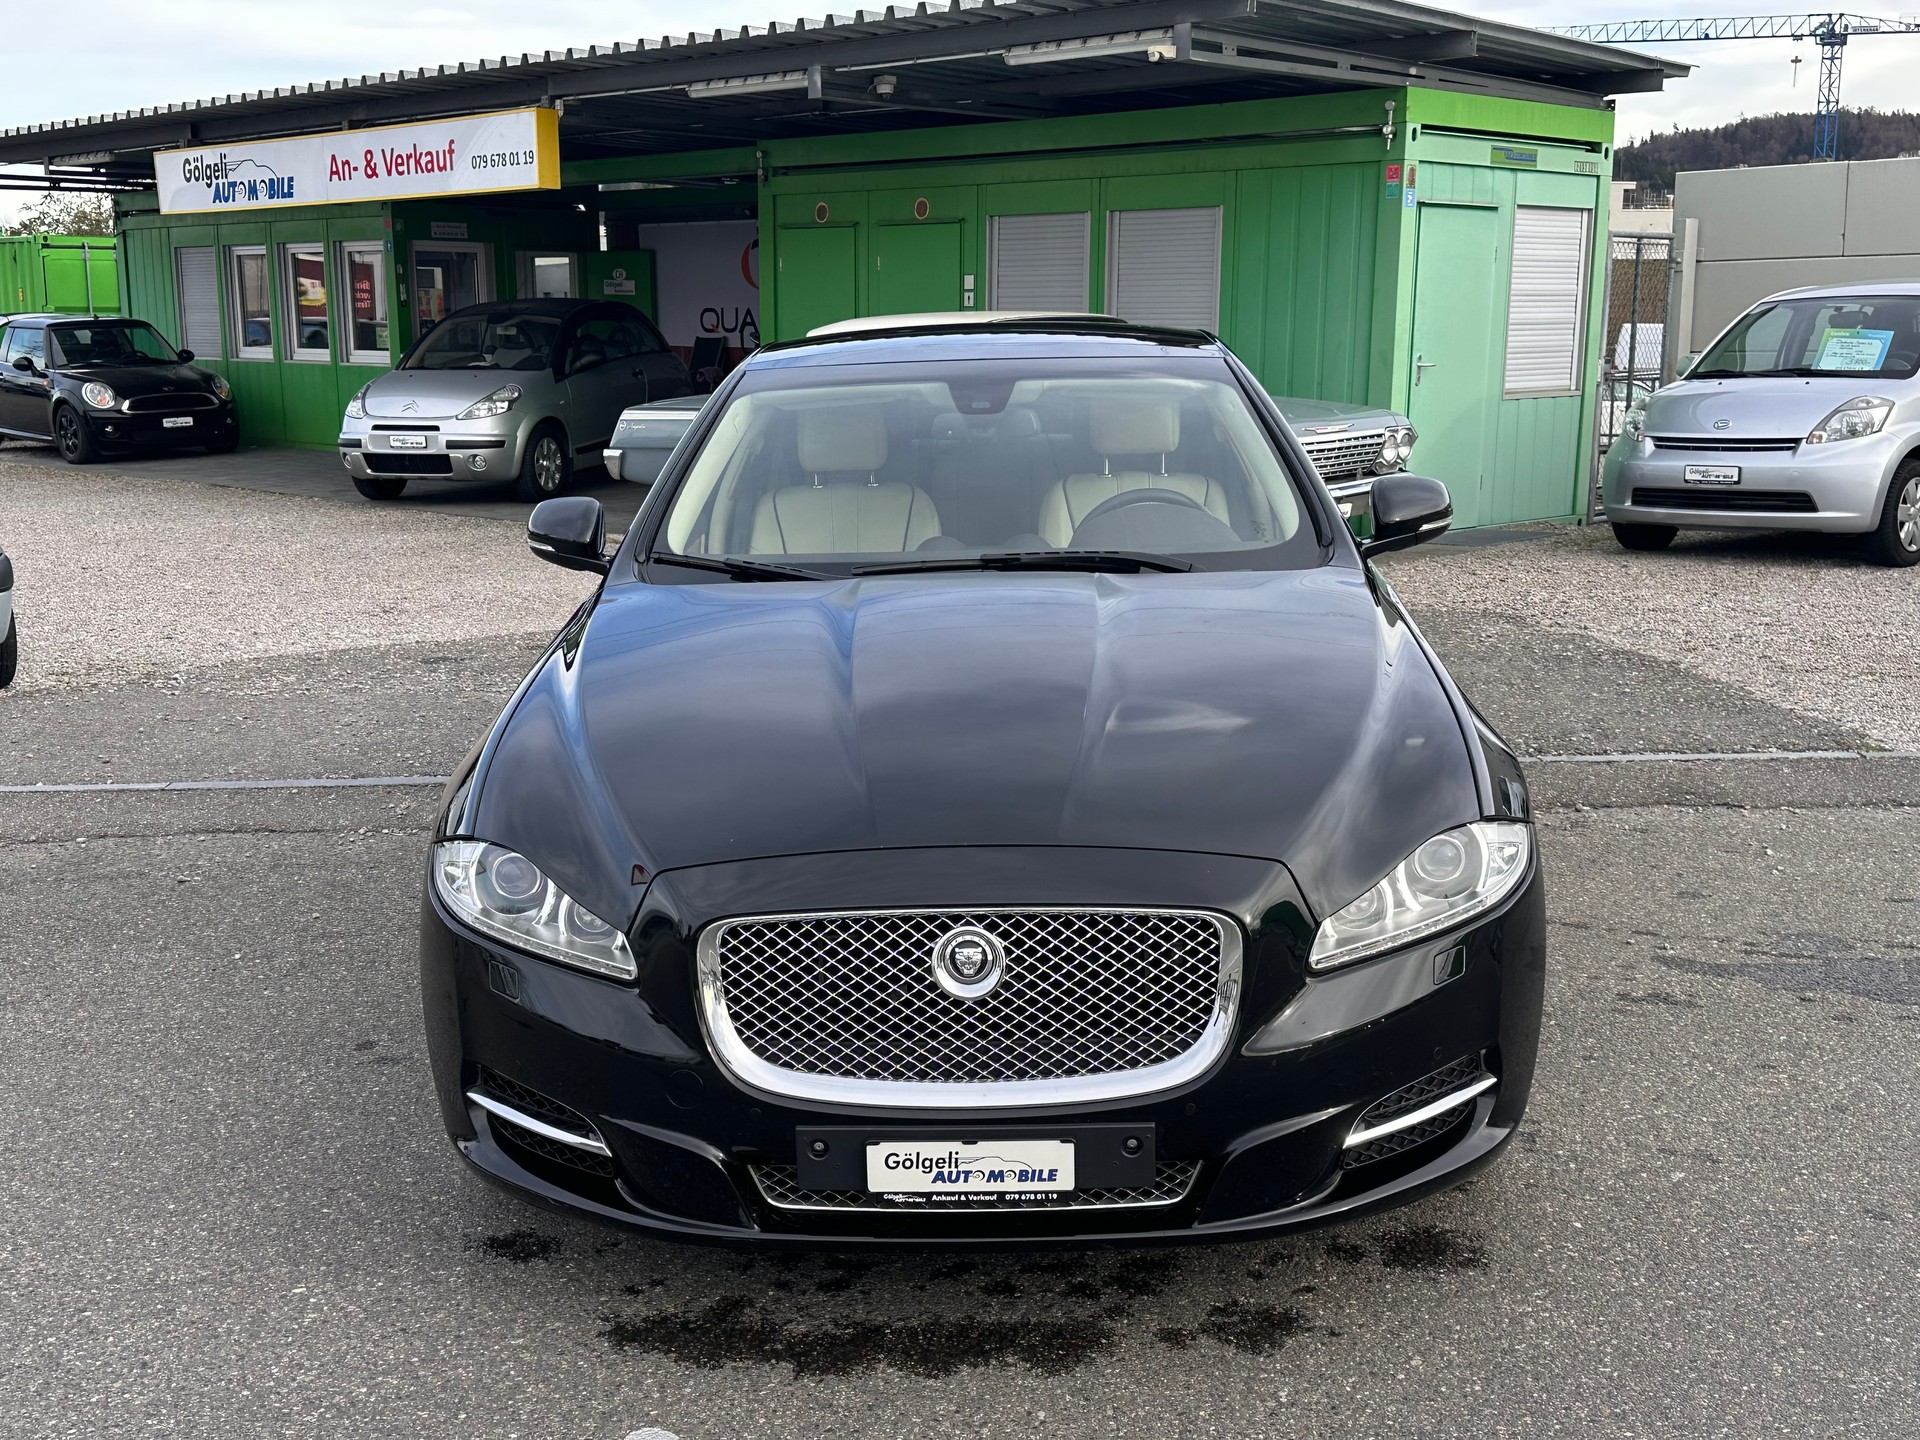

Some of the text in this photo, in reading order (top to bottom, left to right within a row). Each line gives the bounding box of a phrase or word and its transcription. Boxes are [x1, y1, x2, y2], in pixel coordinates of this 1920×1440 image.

[183, 152, 228, 189] Gölgeli
[329, 139, 455, 182] An- & Verkauf
[471, 150, 534, 170] 079 678 01 19
[884, 1151, 960, 1174] Gölgeli
[968, 1193, 997, 1201] Verkauf
[1005, 1193, 1020, 1201] 079
